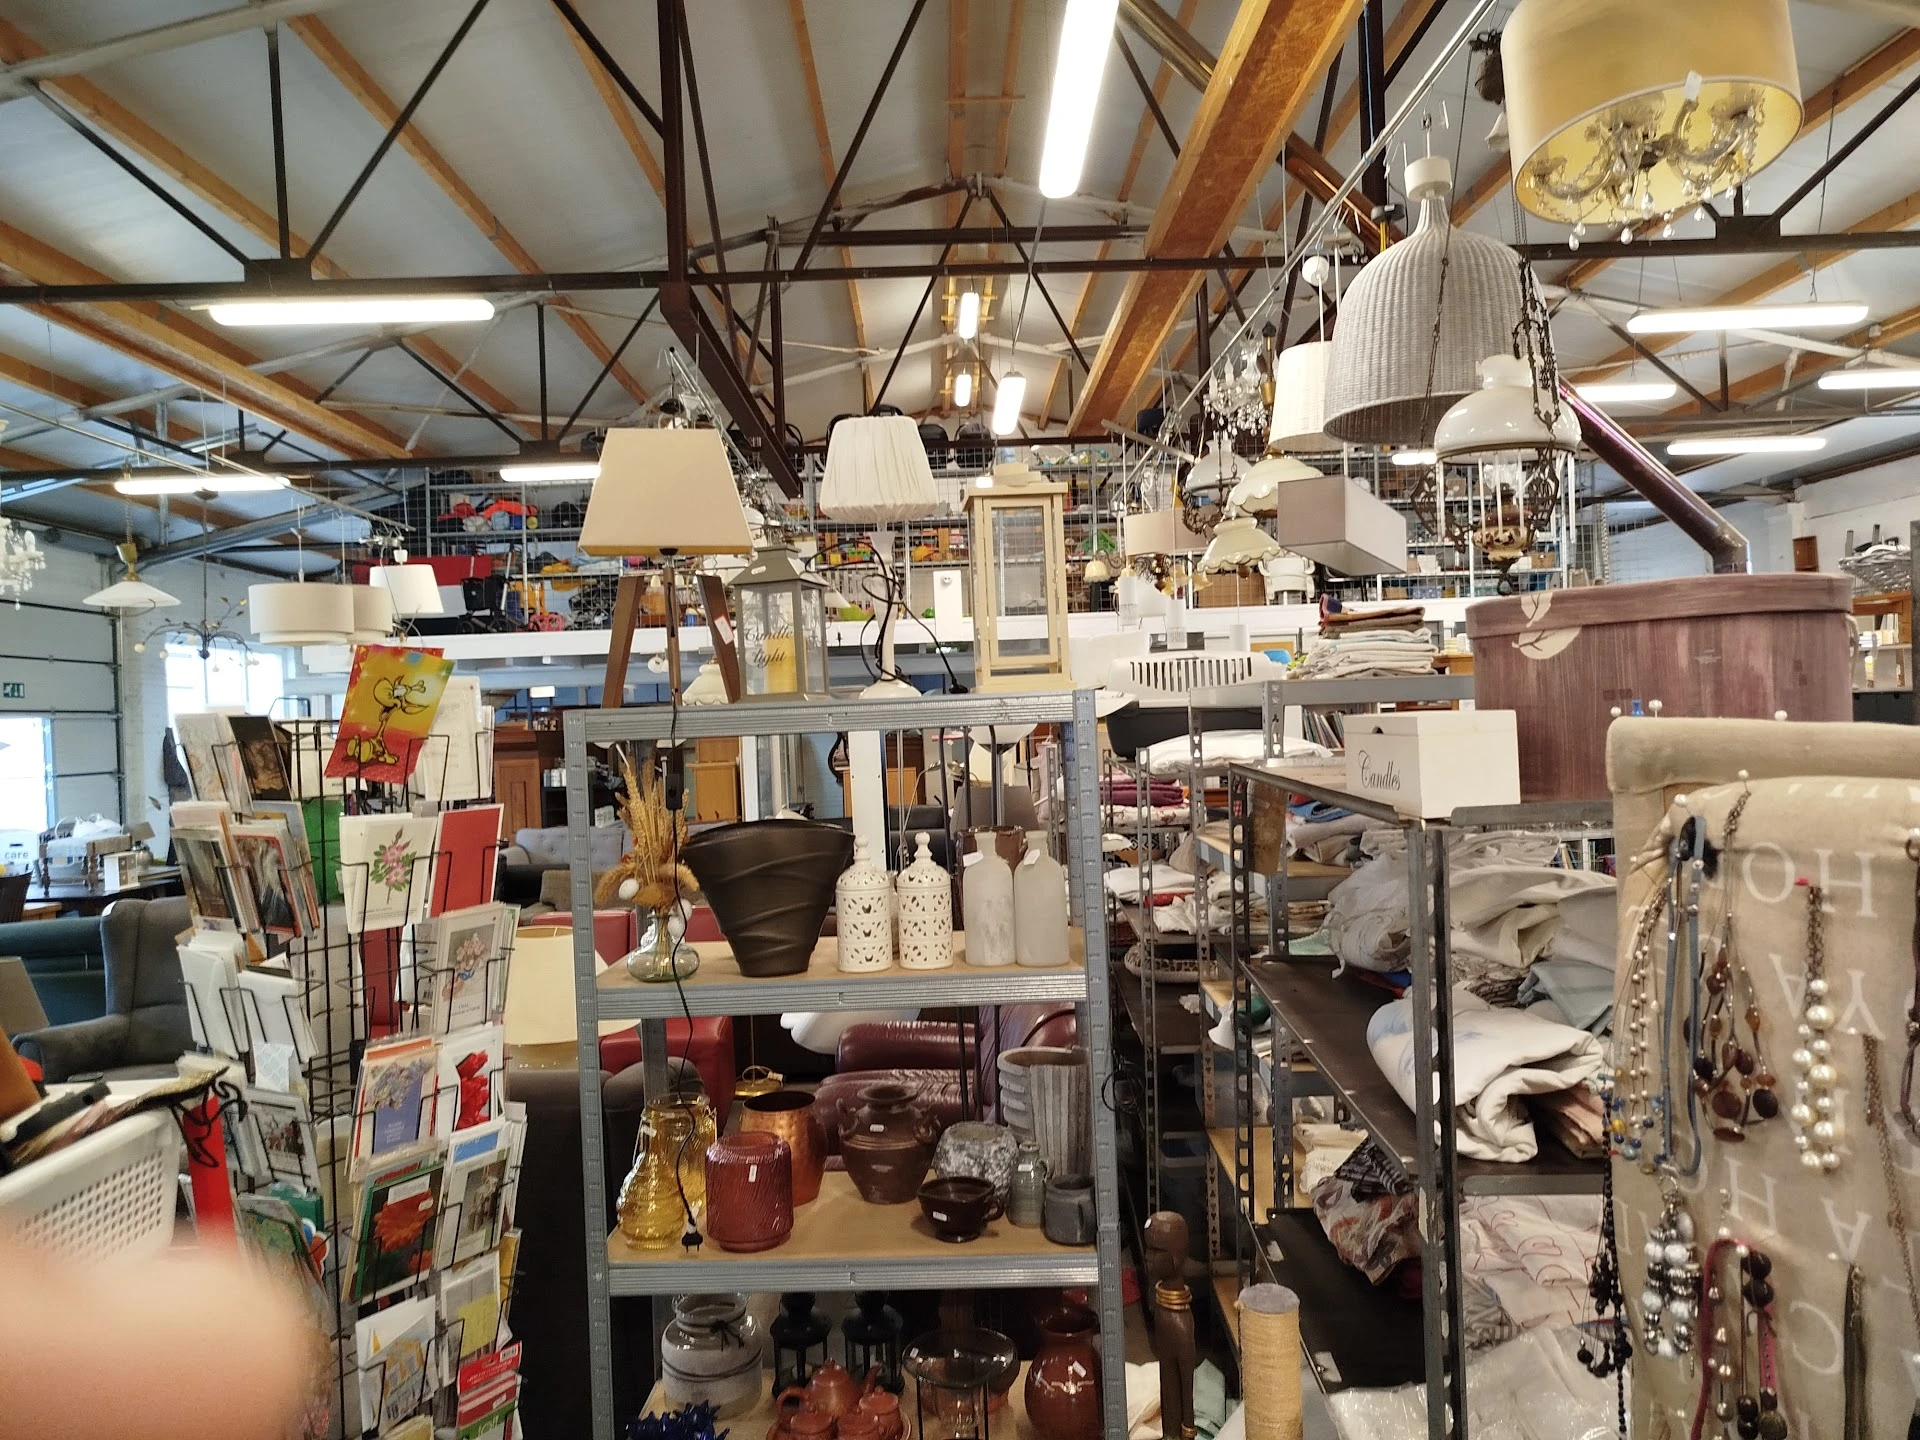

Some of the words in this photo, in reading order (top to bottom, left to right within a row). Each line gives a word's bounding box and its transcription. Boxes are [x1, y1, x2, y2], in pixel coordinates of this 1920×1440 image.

[754, 648, 786, 668] light
[1357, 749, 1401, 791] Candles
[5, 851, 29, 860] care
